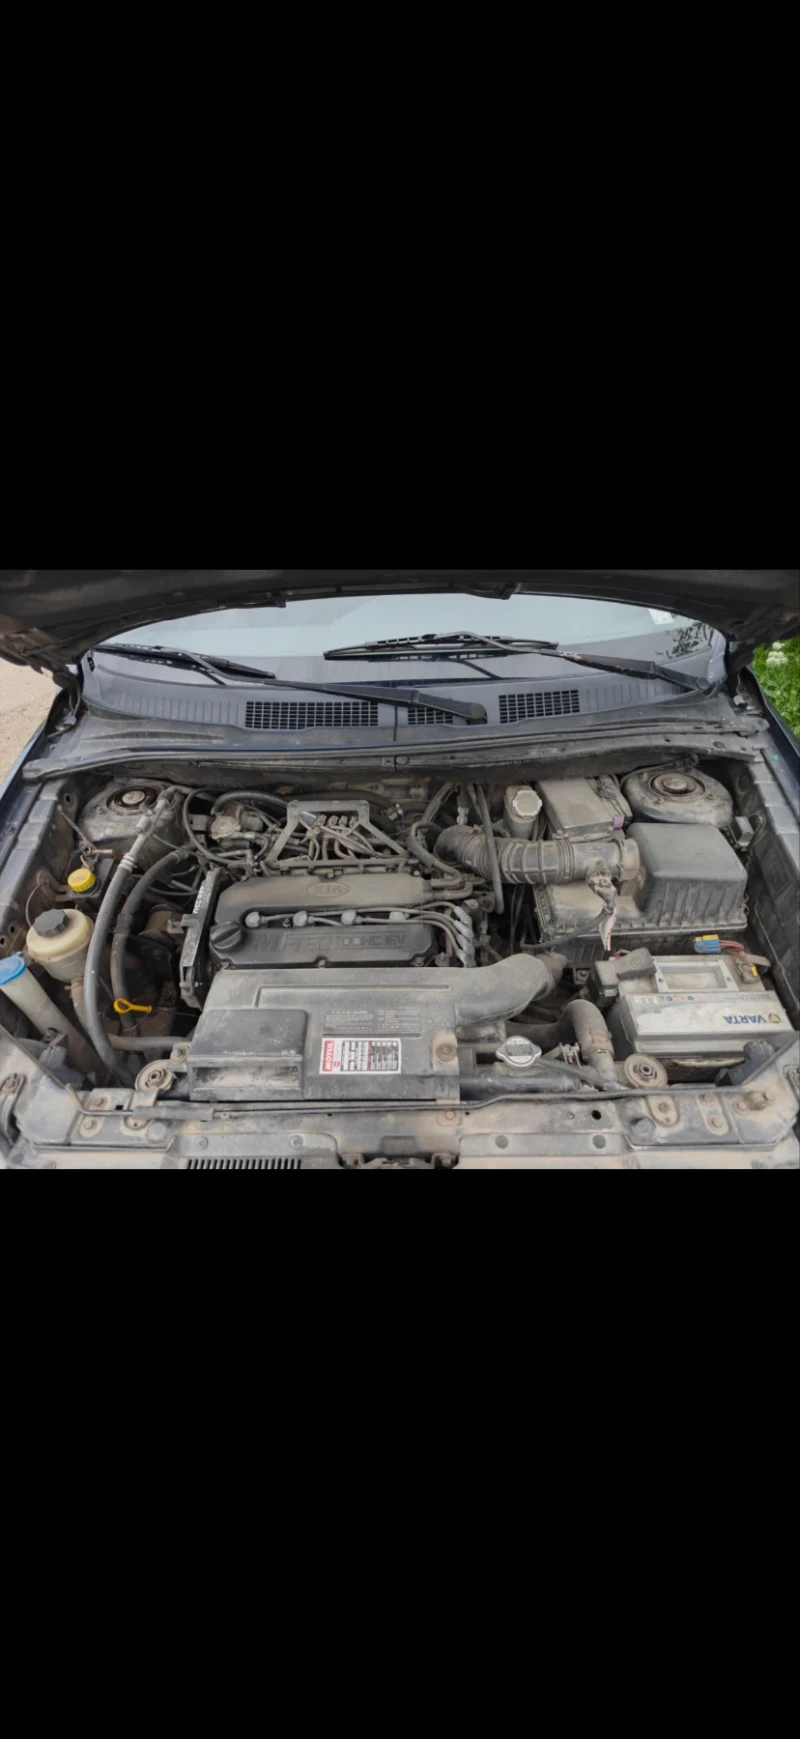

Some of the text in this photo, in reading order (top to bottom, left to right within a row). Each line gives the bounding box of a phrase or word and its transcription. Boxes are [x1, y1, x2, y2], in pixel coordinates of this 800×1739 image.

[312, 884, 347, 896] KIA
[722, 1014, 768, 1025] VARTA
[325, 1042, 333, 1070] MOTUL
